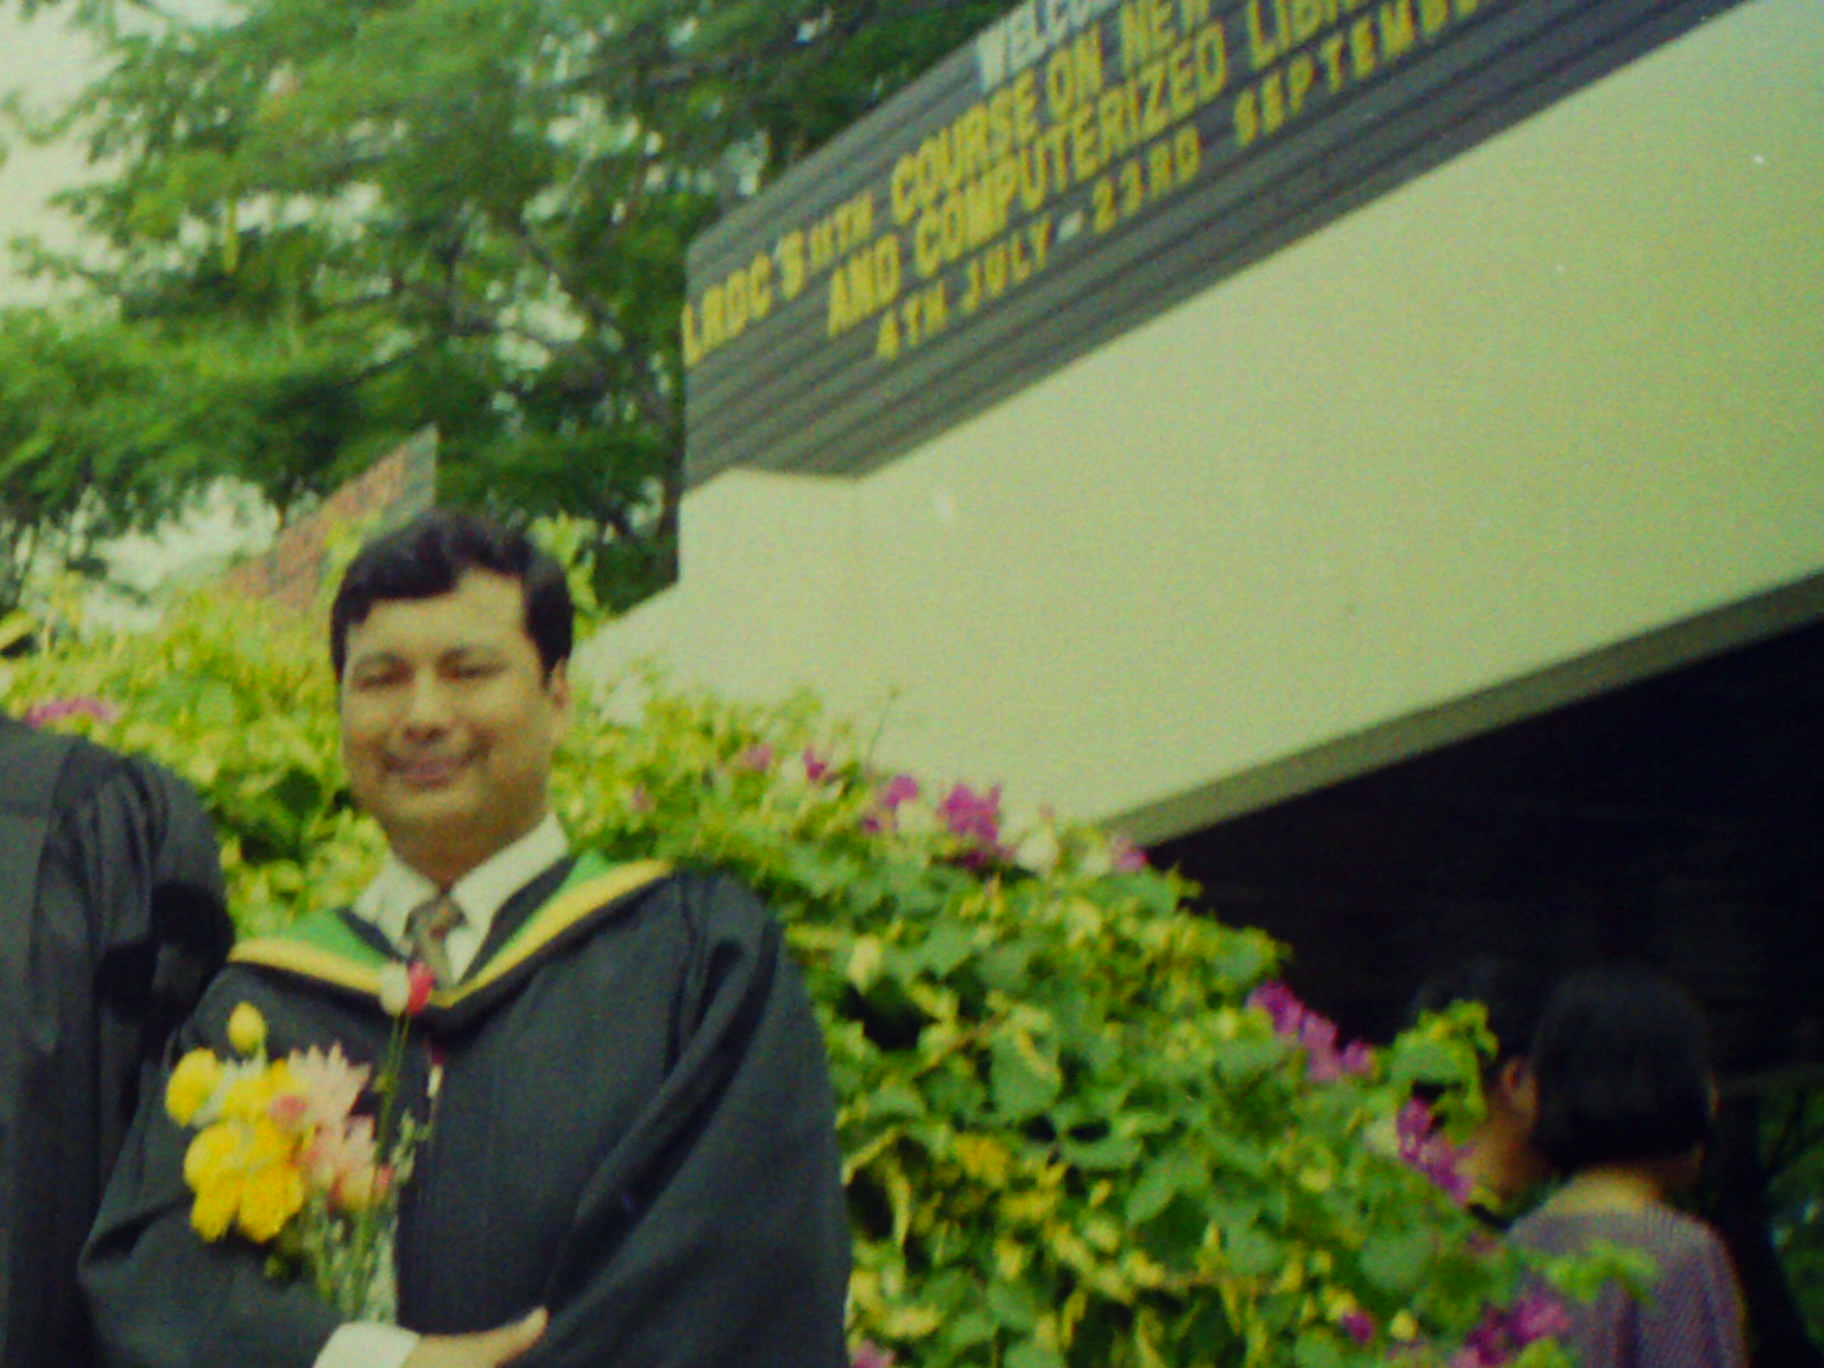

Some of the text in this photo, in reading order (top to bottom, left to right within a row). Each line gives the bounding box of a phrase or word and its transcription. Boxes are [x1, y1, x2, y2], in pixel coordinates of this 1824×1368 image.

[890, 67, 1038, 226] COURSE
[1045, 20, 1102, 121] ON
[977, 0, 1121, 91] WELC
[828, 233, 901, 338] AND
[915, 22, 1226, 278] COMPUTERIZED
[961, 213, 1052, 317] JULY
[1092, 123, 1201, 234] 23RD
